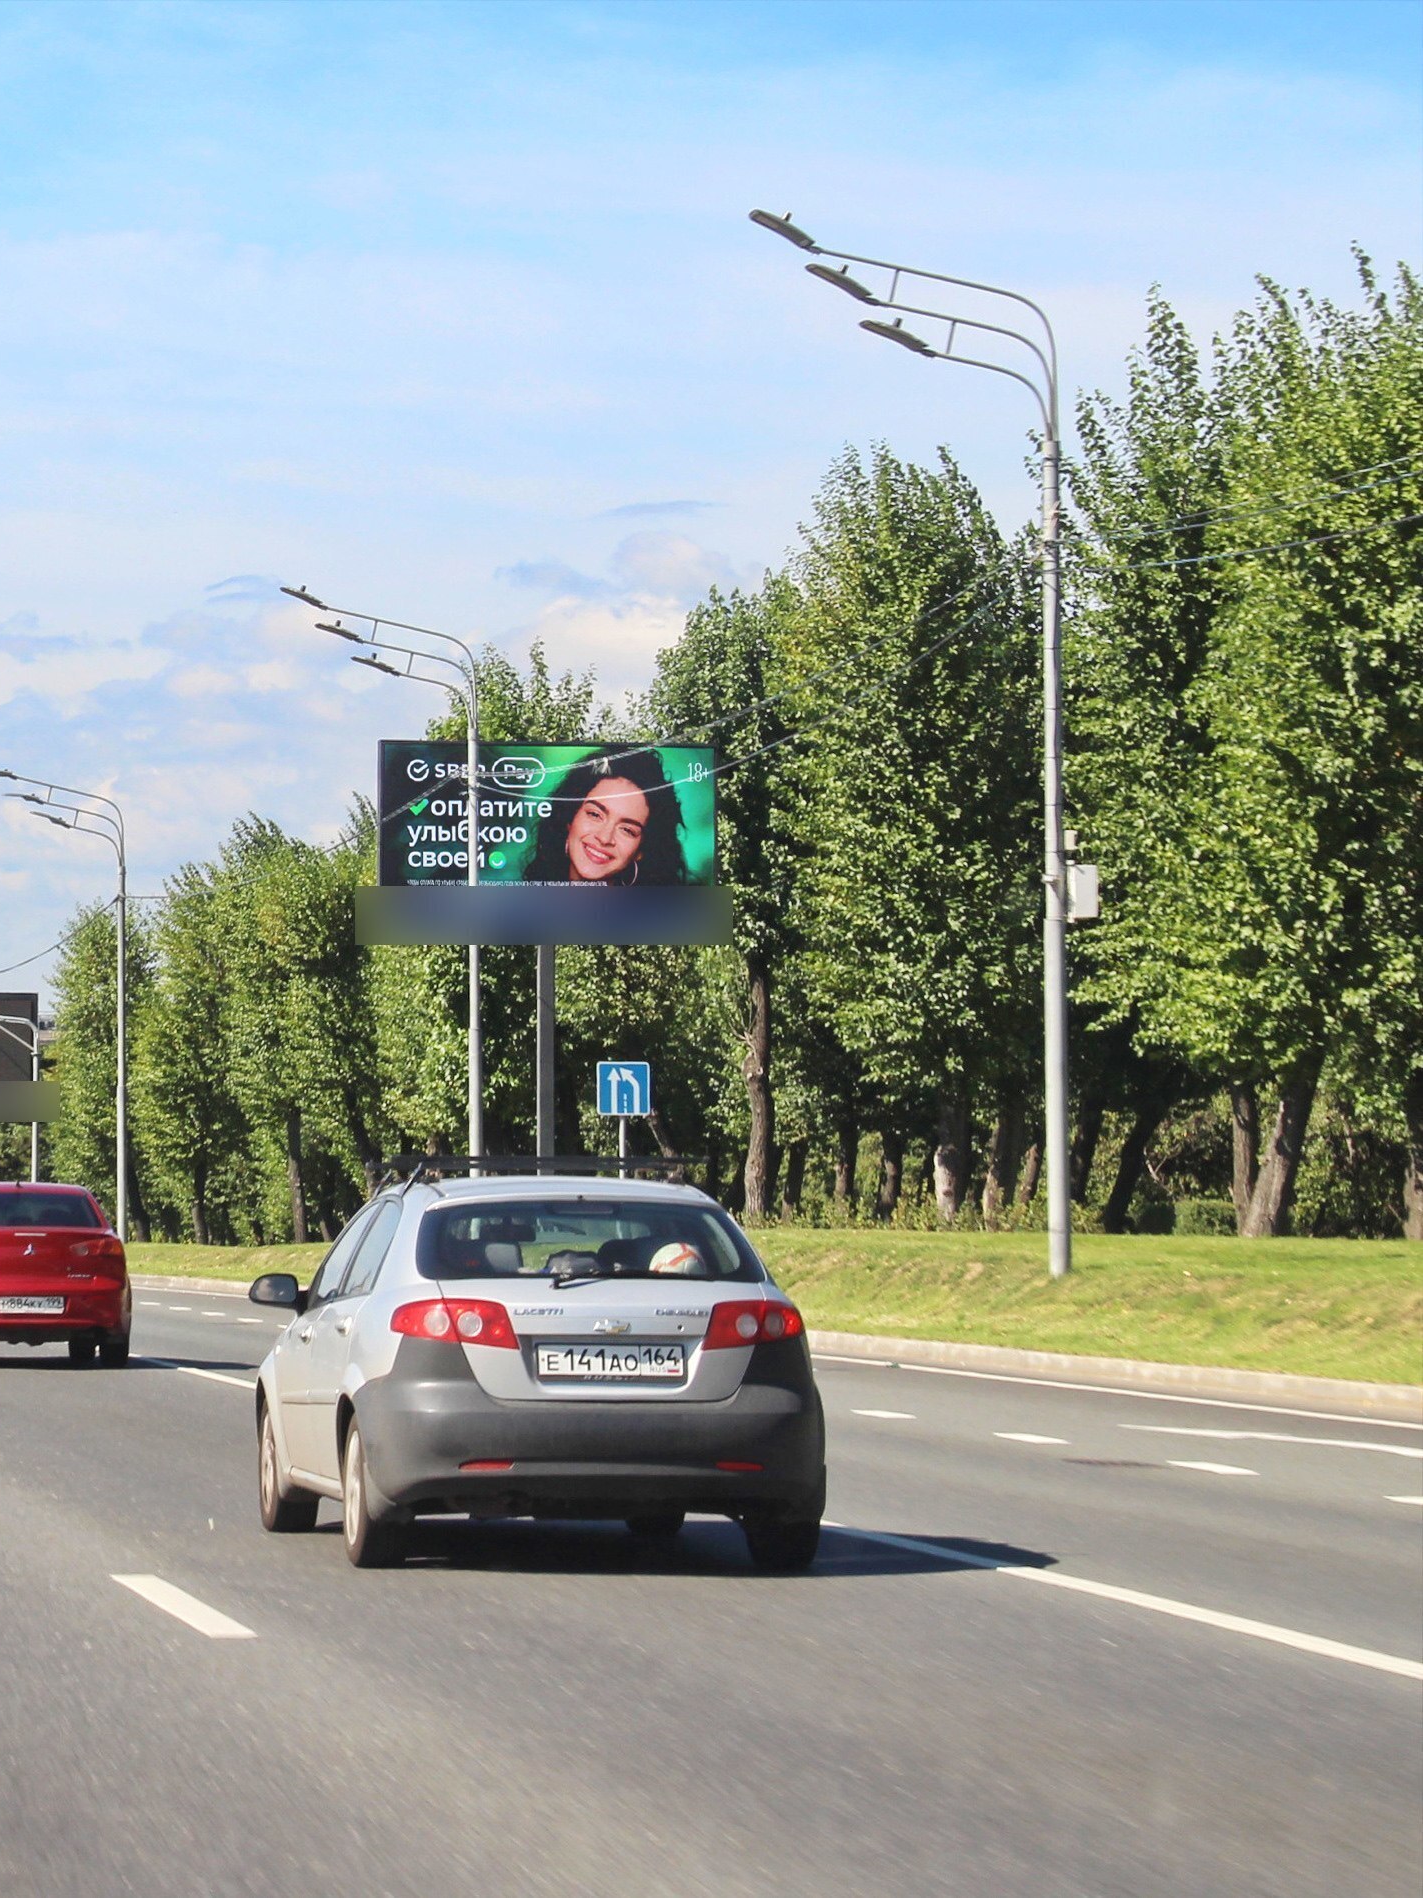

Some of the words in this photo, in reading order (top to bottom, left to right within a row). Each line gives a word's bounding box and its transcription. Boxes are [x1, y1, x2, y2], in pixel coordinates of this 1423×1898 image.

[503, 764, 535, 783] Pay
[687, 762, 710, 783] 18+
[406, 819, 527, 848] улыбкою
[642, 1347, 680, 1366] 164
